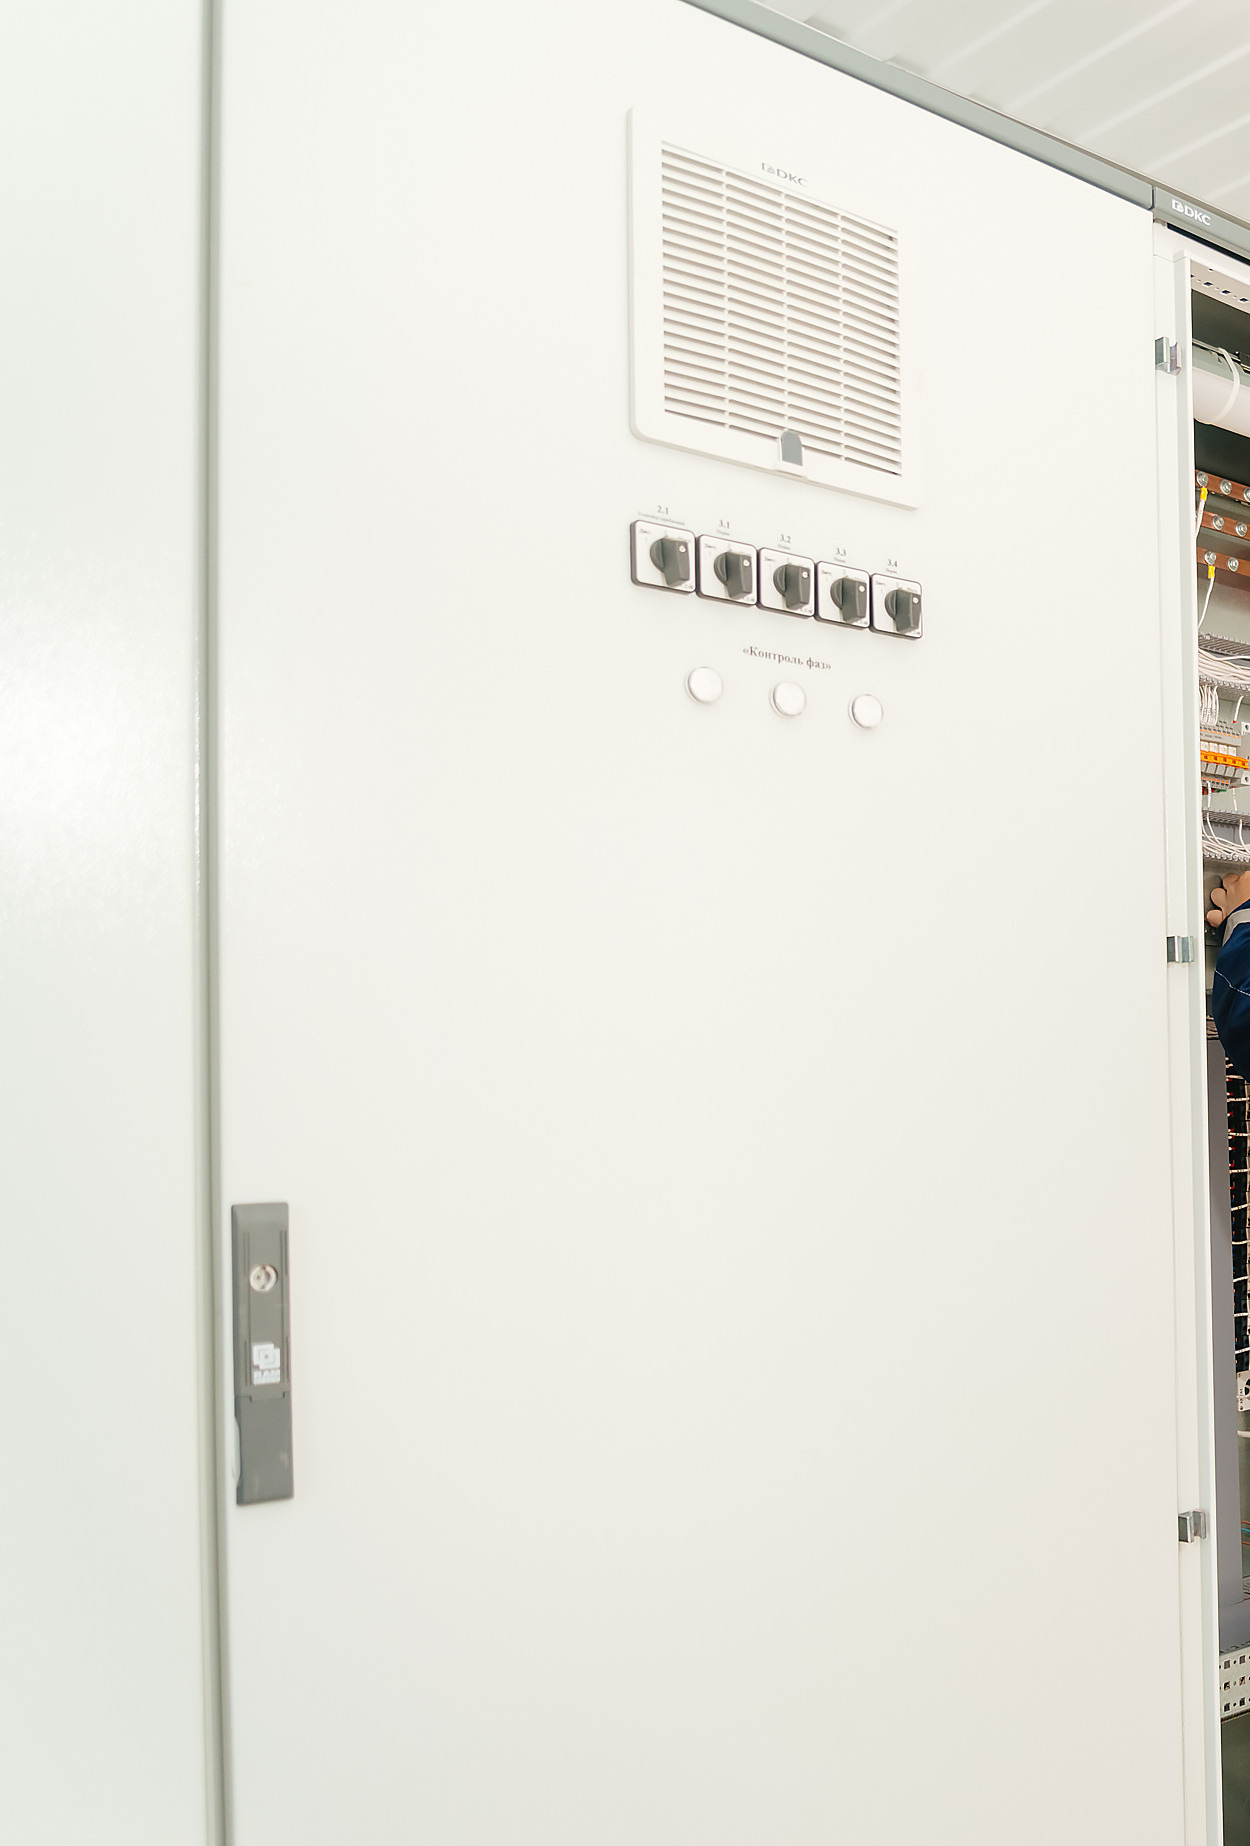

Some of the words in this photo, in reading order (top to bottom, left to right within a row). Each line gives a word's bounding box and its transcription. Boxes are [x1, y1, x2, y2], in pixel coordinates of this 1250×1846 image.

[1184, 205, 1211, 226] DKC
[657, 505, 668, 514] 2.1
[719, 519, 730, 529] 3.1
[780, 534, 791, 543] 3.2
[836, 547, 846, 556] 3.3
[887, 558, 898, 567] 3.4
[742, 646, 804, 664] «Контроль
[806, 657, 831, 670] фаз»
